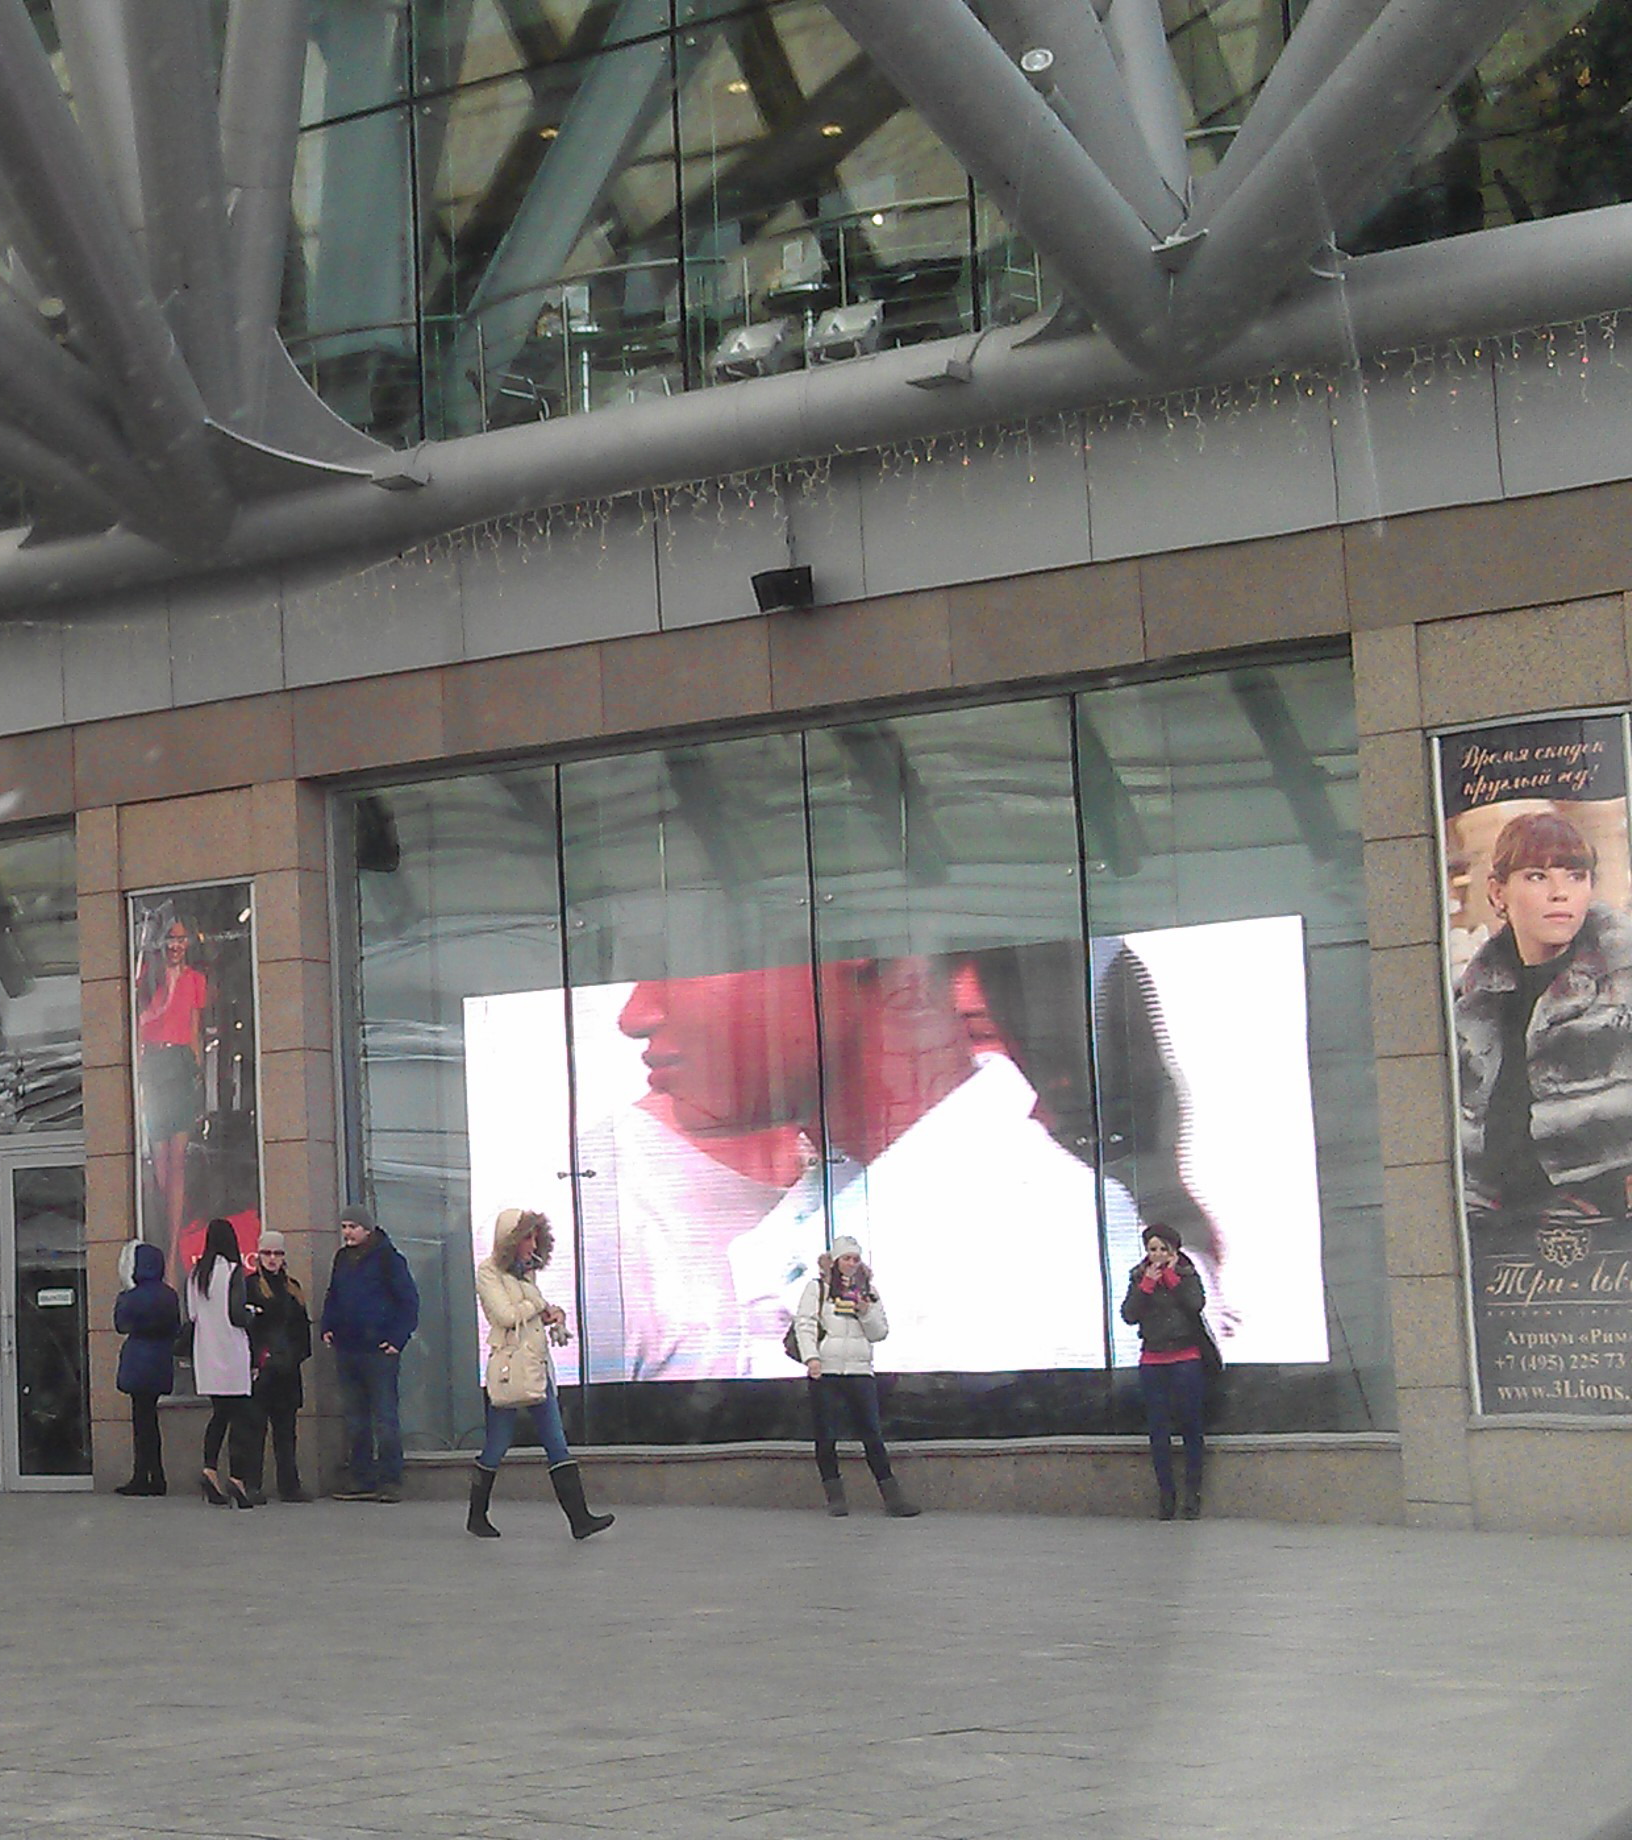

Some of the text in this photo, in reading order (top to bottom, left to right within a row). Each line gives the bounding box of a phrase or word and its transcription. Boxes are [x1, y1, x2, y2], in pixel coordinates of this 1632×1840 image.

[1462, 745, 1529, 775] Время
[1464, 769, 1551, 804] круглый
[1485, 1262, 1564, 1307] Три
[1504, 1329, 1574, 1350] Атриум
[1495, 1354, 1515, 1370] +7
[1520, 1353, 1565, 1373] (495)
[1570, 1352, 1599, 1370] 225
[1497, 1378, 1632, 1400] www.3Lions.
